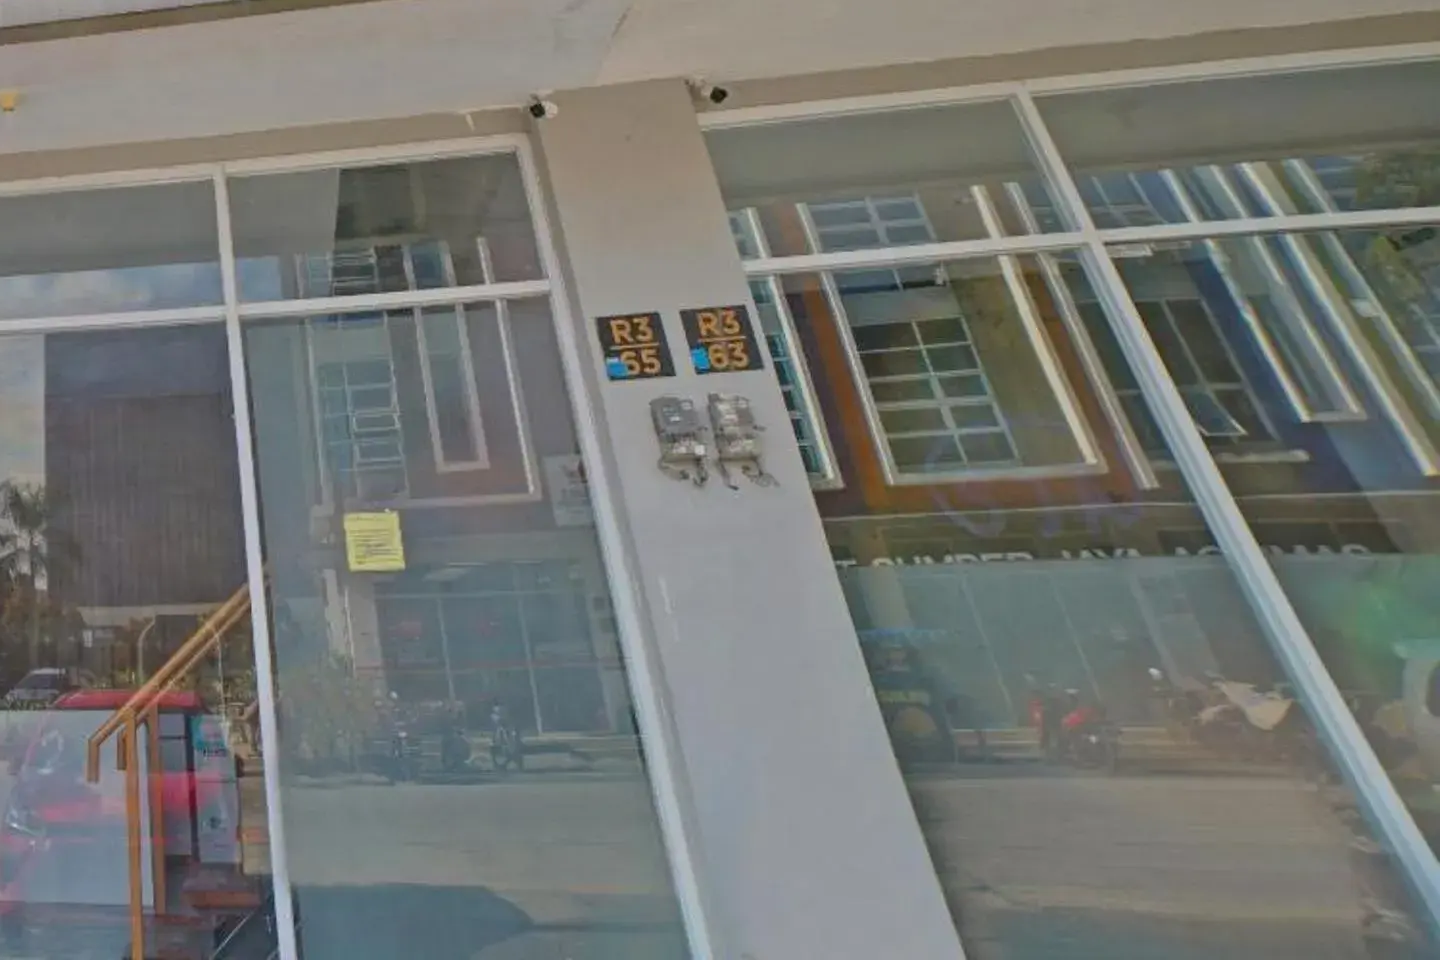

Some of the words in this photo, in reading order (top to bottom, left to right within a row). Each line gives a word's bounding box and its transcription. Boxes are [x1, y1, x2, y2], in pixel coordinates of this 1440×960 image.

[610, 316, 653, 344] R3
[699, 311, 740, 336] R3
[620, 349, 661, 375] 65
[708, 341, 749, 369] 63
